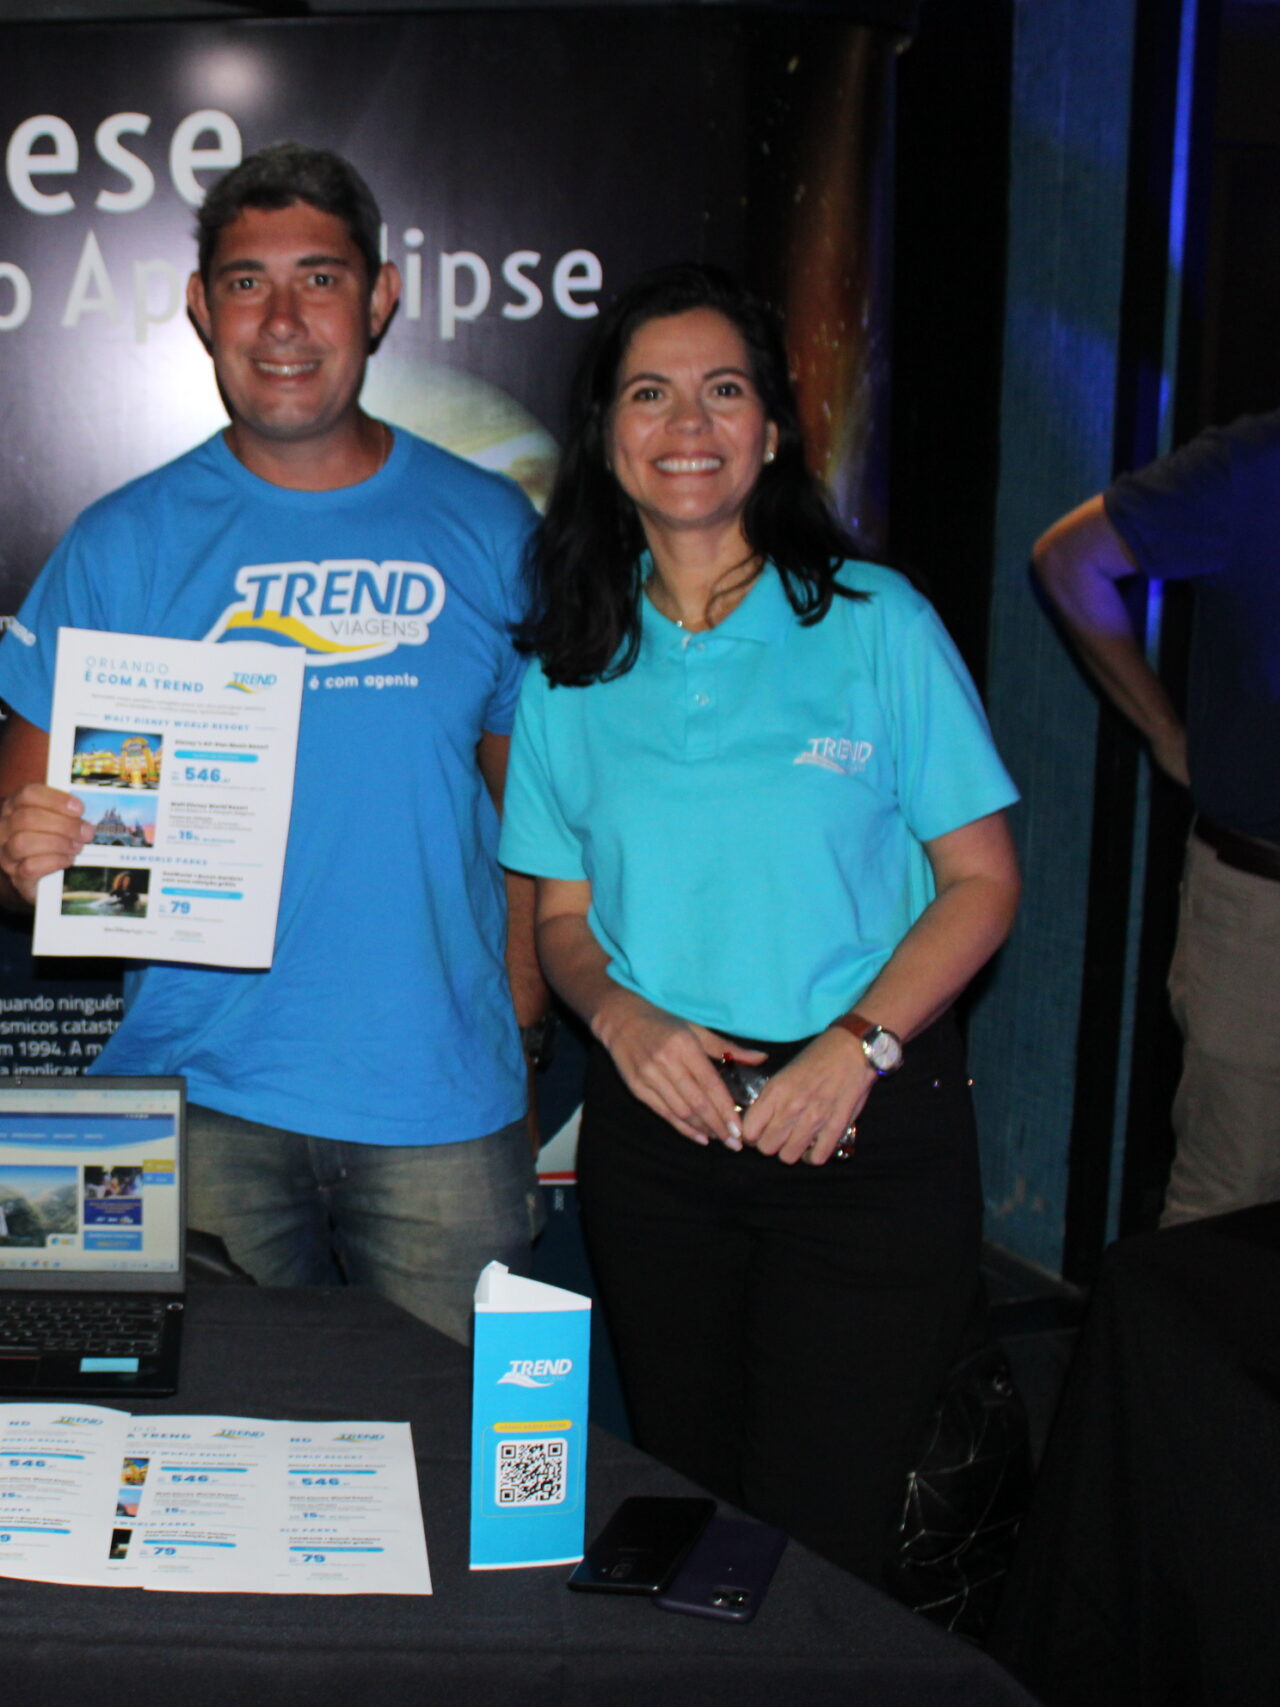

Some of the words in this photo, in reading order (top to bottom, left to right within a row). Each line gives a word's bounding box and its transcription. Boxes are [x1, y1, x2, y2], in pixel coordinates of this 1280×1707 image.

[61, 223, 604, 343] Apipse
[246, 570, 436, 619] TREND
[330, 618, 420, 638] VIAGENS
[85, 656, 169, 676] ORLANDO
[97, 673, 132, 687] COM
[138, 677, 147, 688] A
[154, 679, 204, 693] TREND
[232, 671, 277, 686] TREND
[309, 675, 320, 690] é
[325, 676, 359, 690] com
[364, 673, 418, 690] agente
[808, 737, 873, 762] TREND
[185, 766, 221, 782] 546
[171, 901, 191, 914] 79
[69, 1040, 82, 1056] A
[509, 1359, 573, 1376] TREND
[153, 1547, 176, 1555] 79
